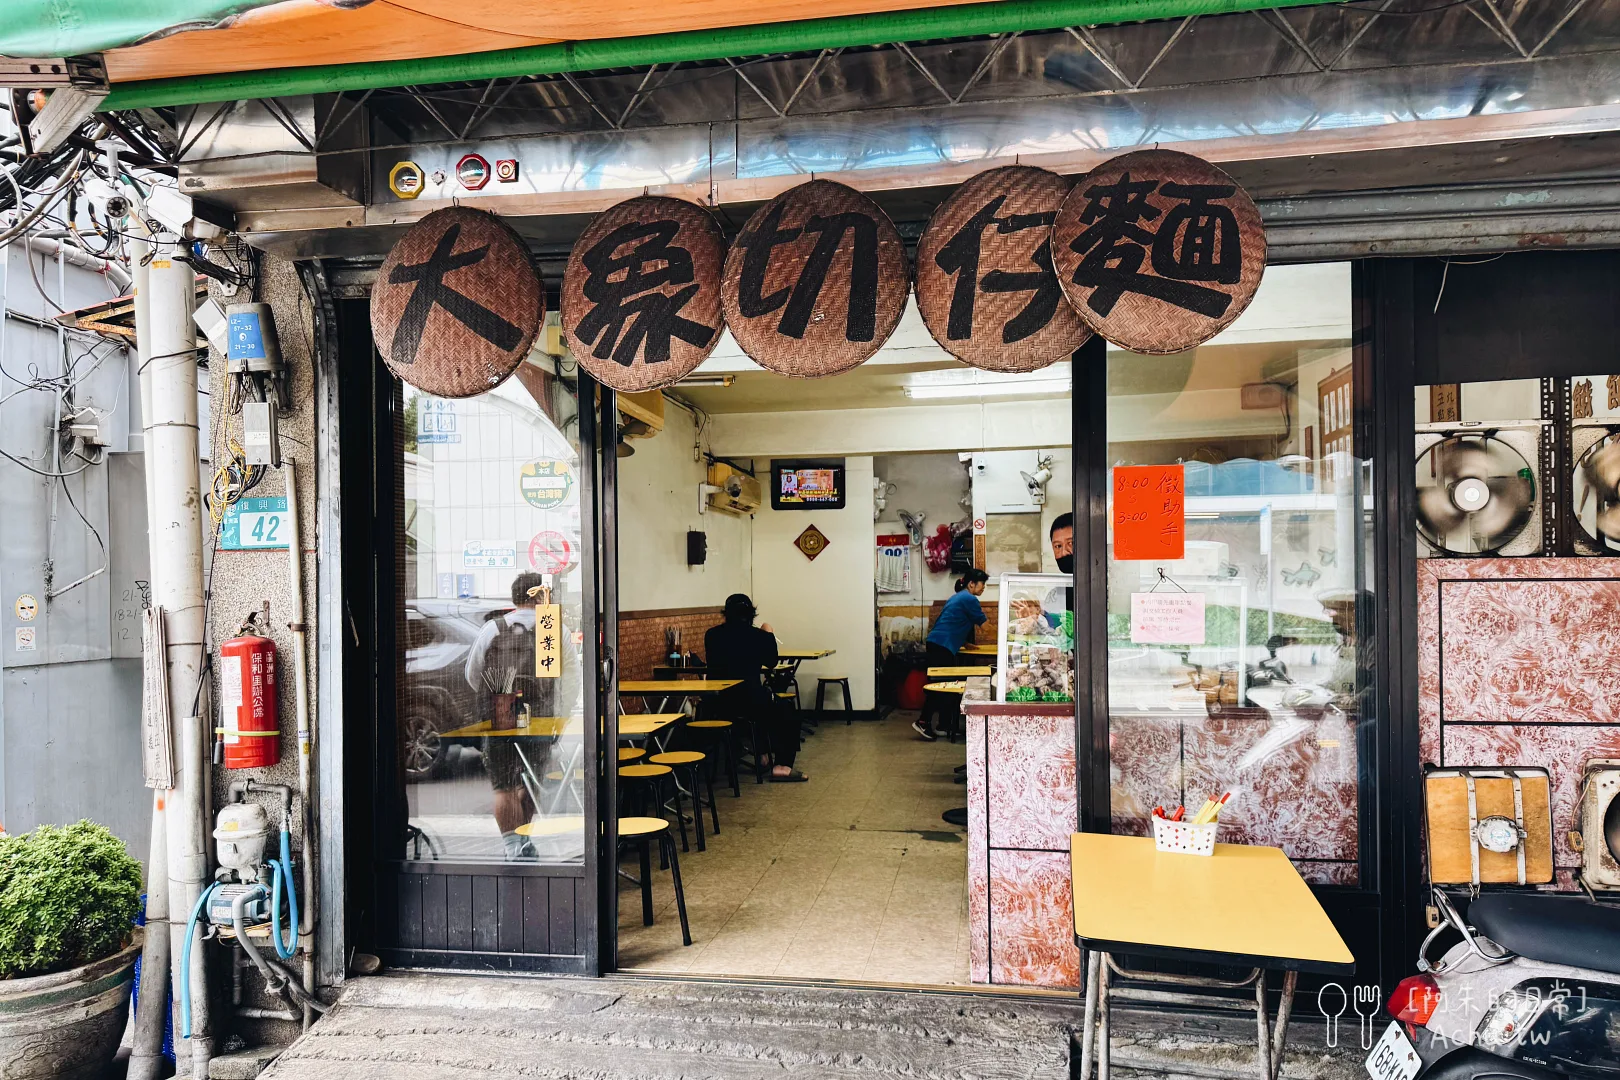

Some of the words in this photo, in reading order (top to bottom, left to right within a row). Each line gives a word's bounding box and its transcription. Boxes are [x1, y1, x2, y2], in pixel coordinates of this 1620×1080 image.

[241, 499, 287, 510] 復興路
[1118, 475, 1149, 492] 8:00
[252, 516, 280, 542] 42
[1155, 471, 1182, 546] 徵助手
[540, 614, 555, 672] 營業中
[252, 652, 264, 718] 保和里辦公處
